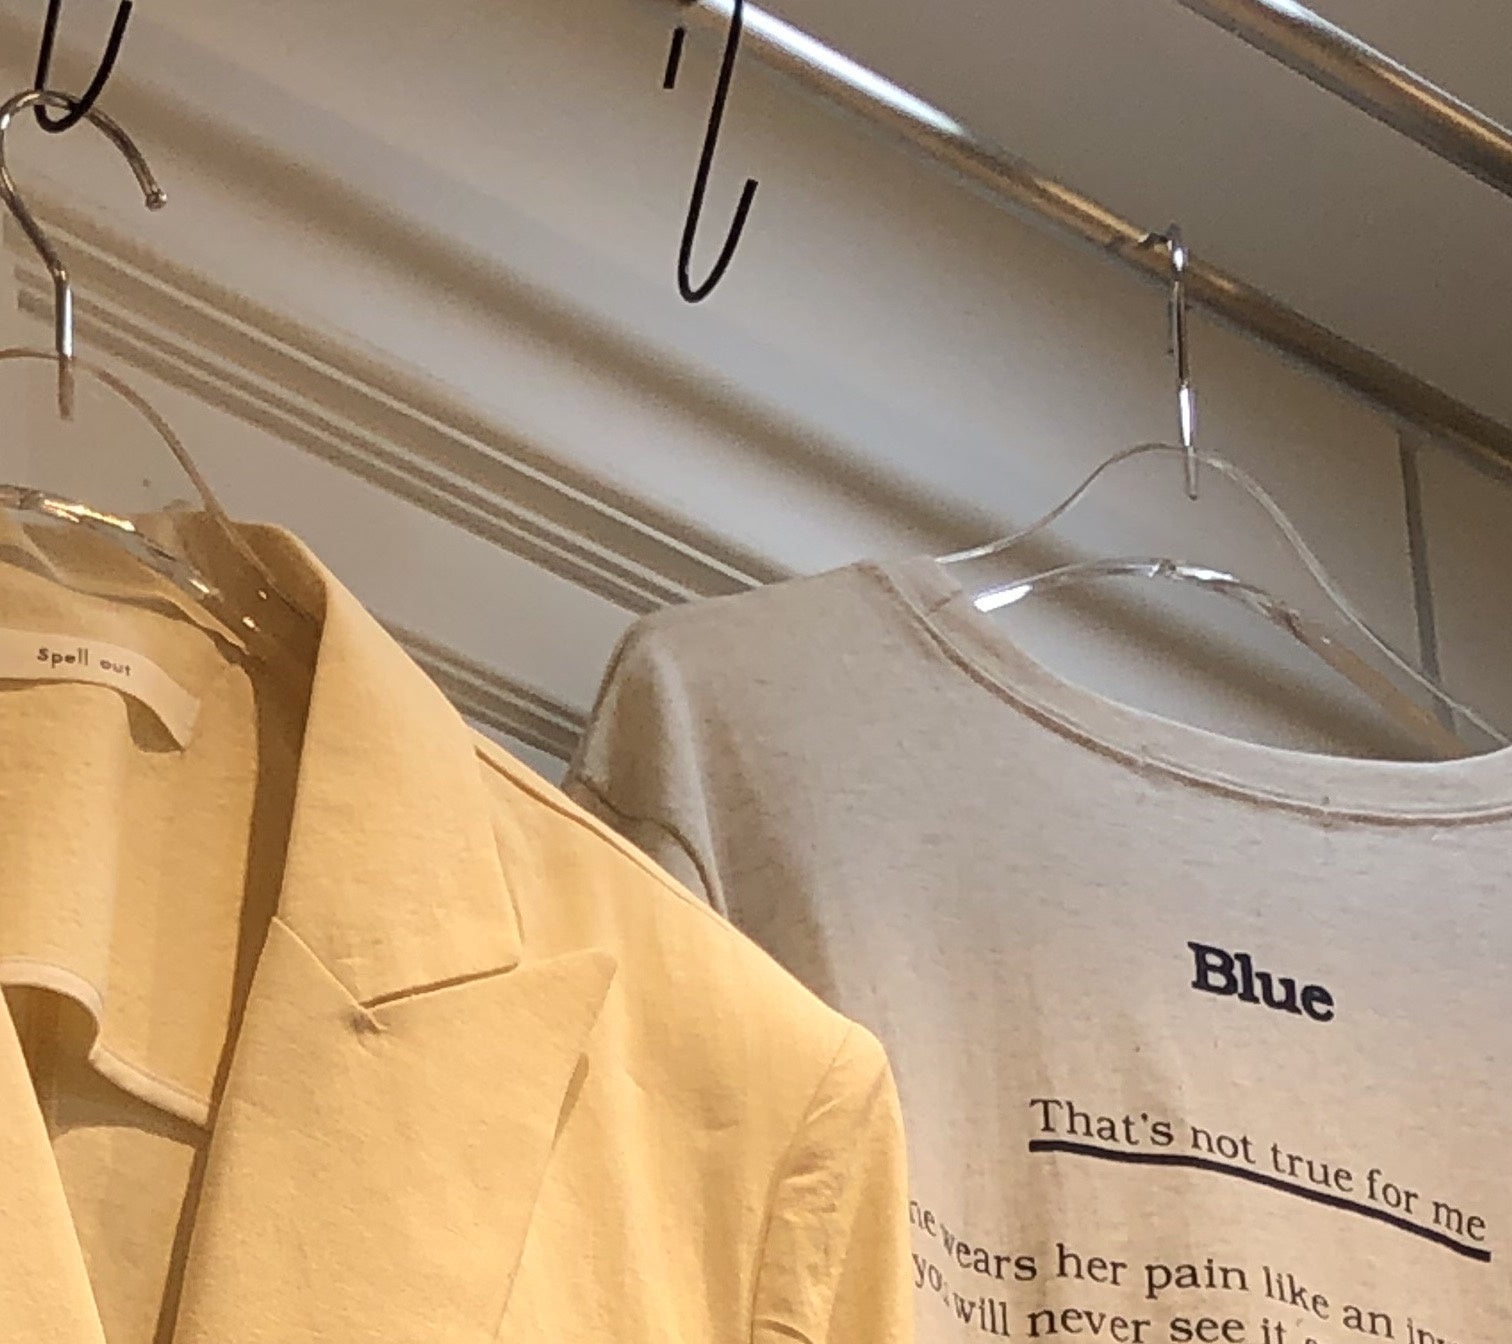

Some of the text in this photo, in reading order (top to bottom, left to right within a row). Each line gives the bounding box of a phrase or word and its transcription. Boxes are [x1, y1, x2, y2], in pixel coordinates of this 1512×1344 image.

[37, 647, 132, 676] Spell out
[1188, 942, 1335, 1022] Blue
[1029, 1098, 1487, 1241] That's not true for me
[952, 1292, 1010, 1336] will
[1027, 1307, 1150, 1343] never
[1170, 1318, 1245, 1343] see
[1056, 1243, 1127, 1286] her
[1145, 1258, 1249, 1299] pain
[1263, 1266, 1329, 1319] like
[1343, 1305, 1394, 1339] an
